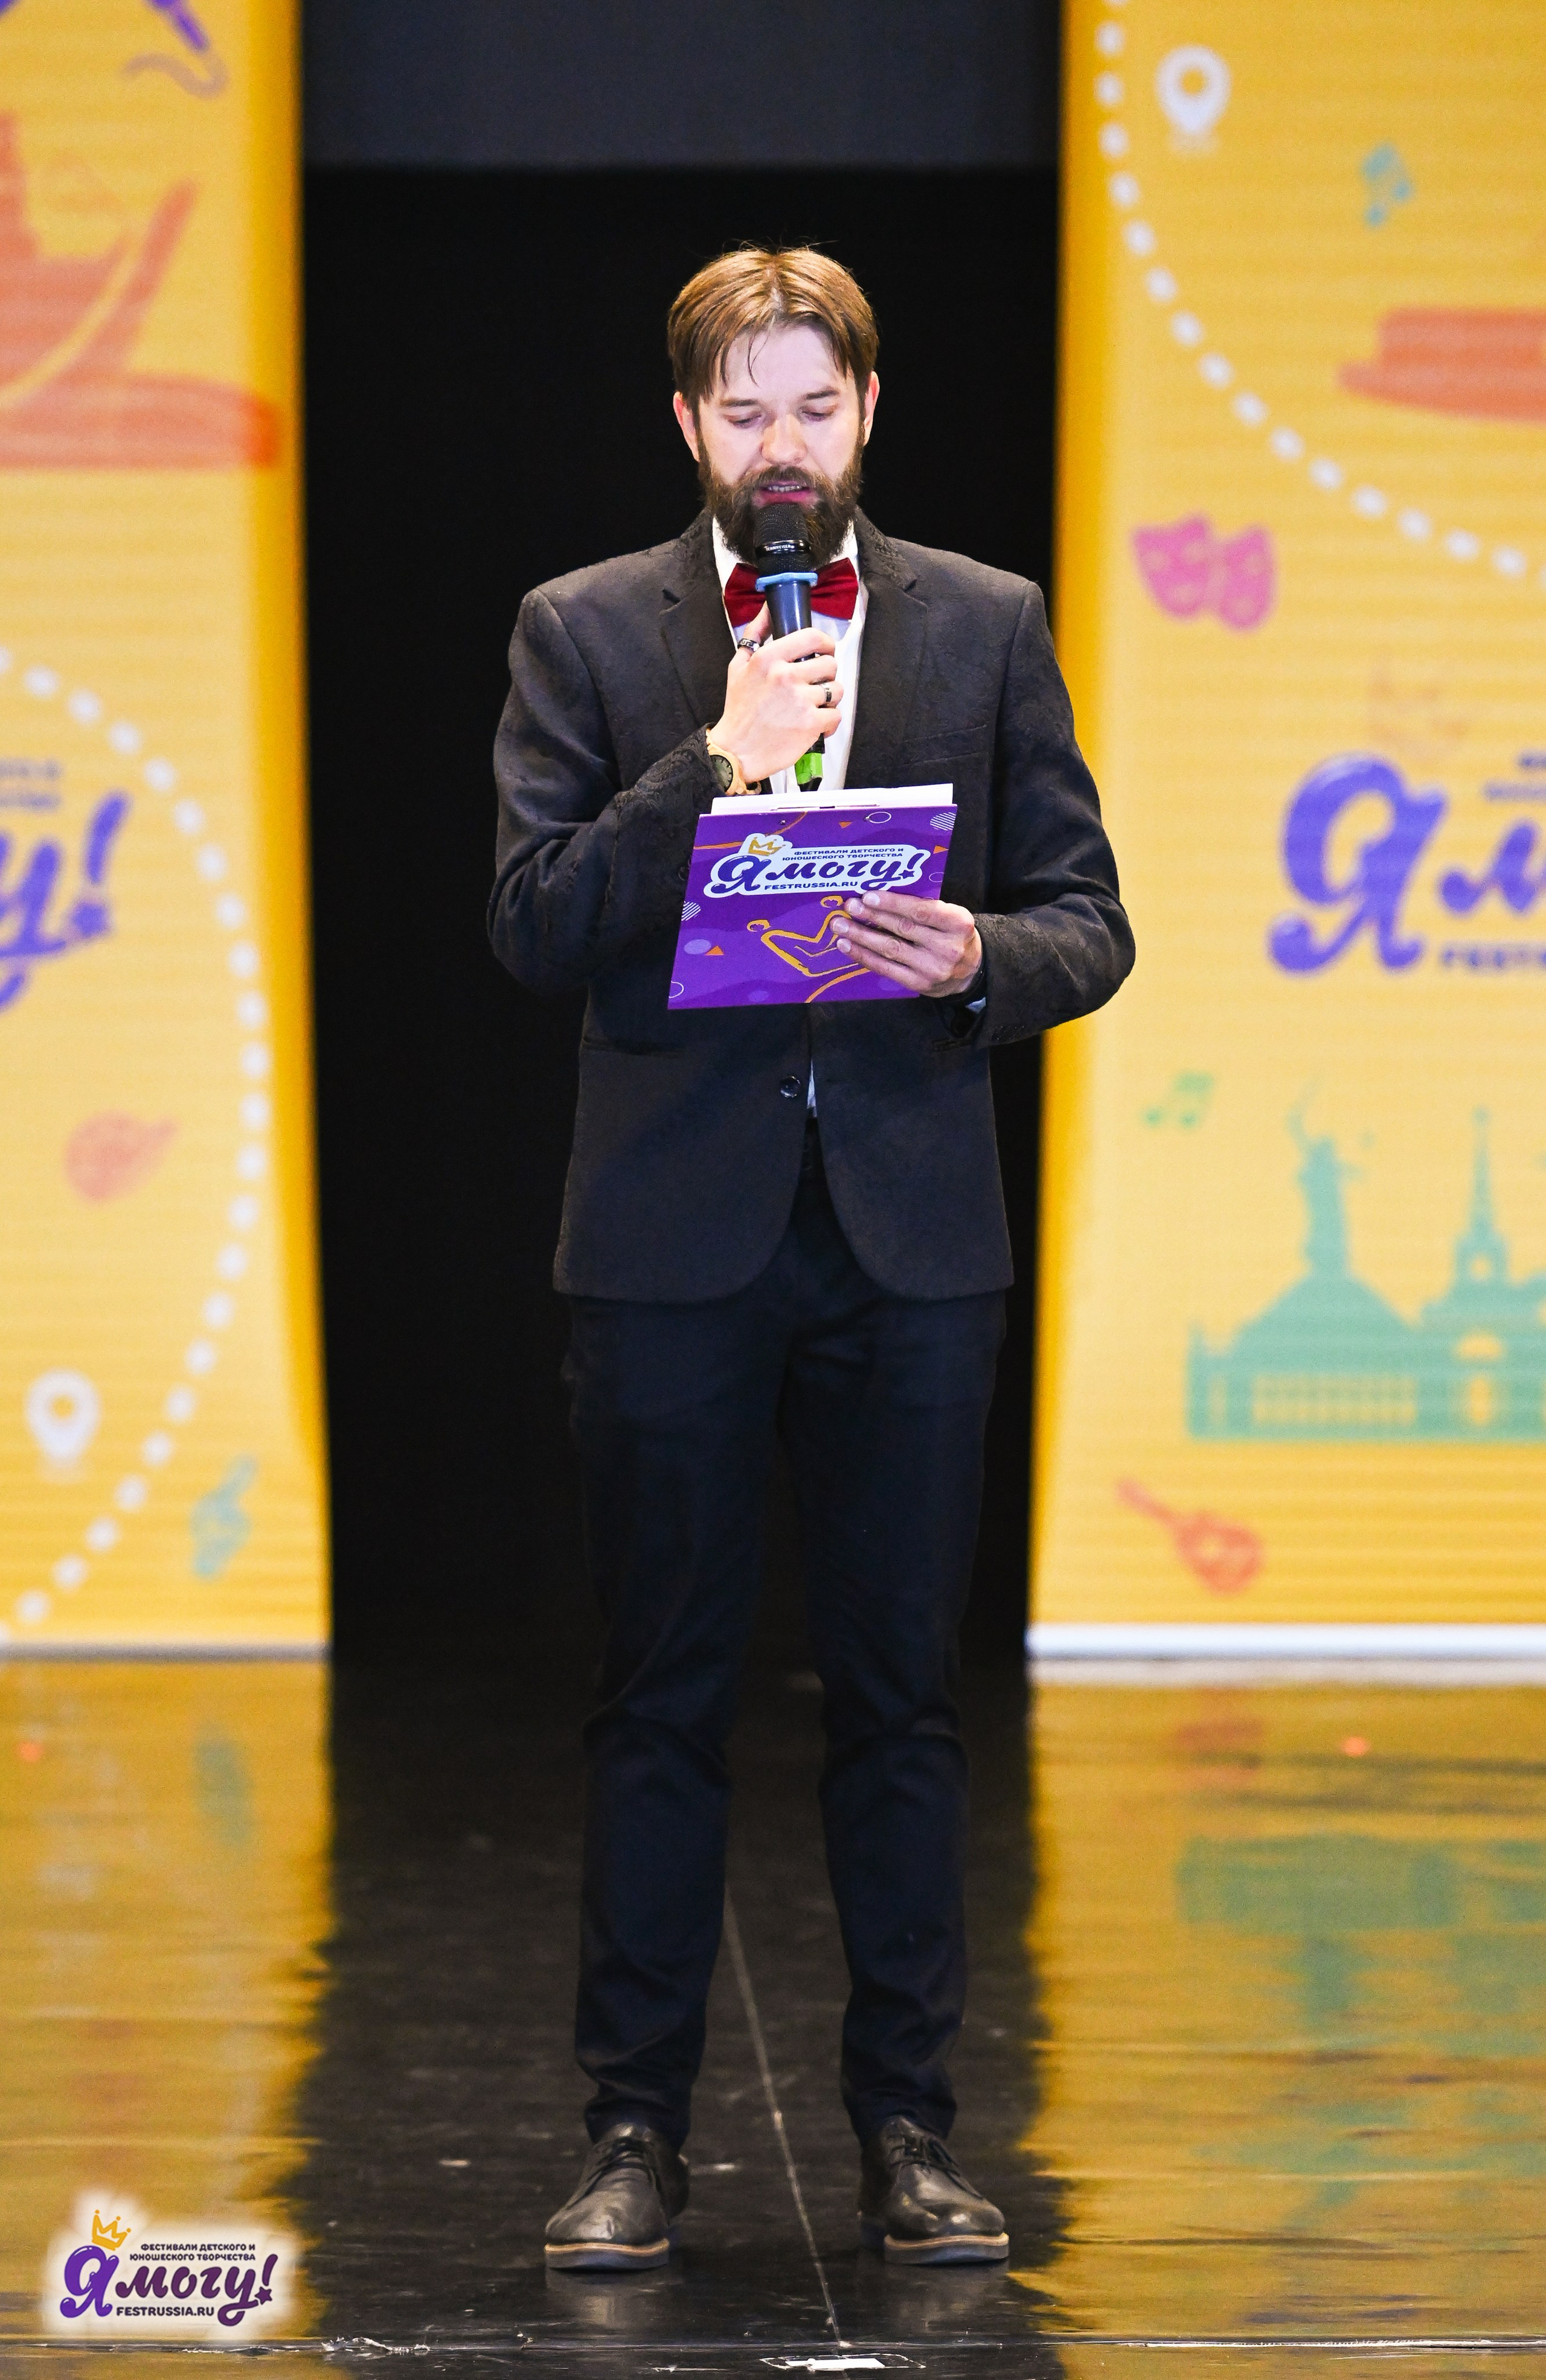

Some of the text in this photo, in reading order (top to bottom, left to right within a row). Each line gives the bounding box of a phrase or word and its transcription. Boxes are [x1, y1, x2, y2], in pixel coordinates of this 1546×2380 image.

[710, 853, 925, 894] Я могу!
[1264, 752, 1446, 978] Я
[764, 881, 858, 891] FESTRUSSIA.RU
